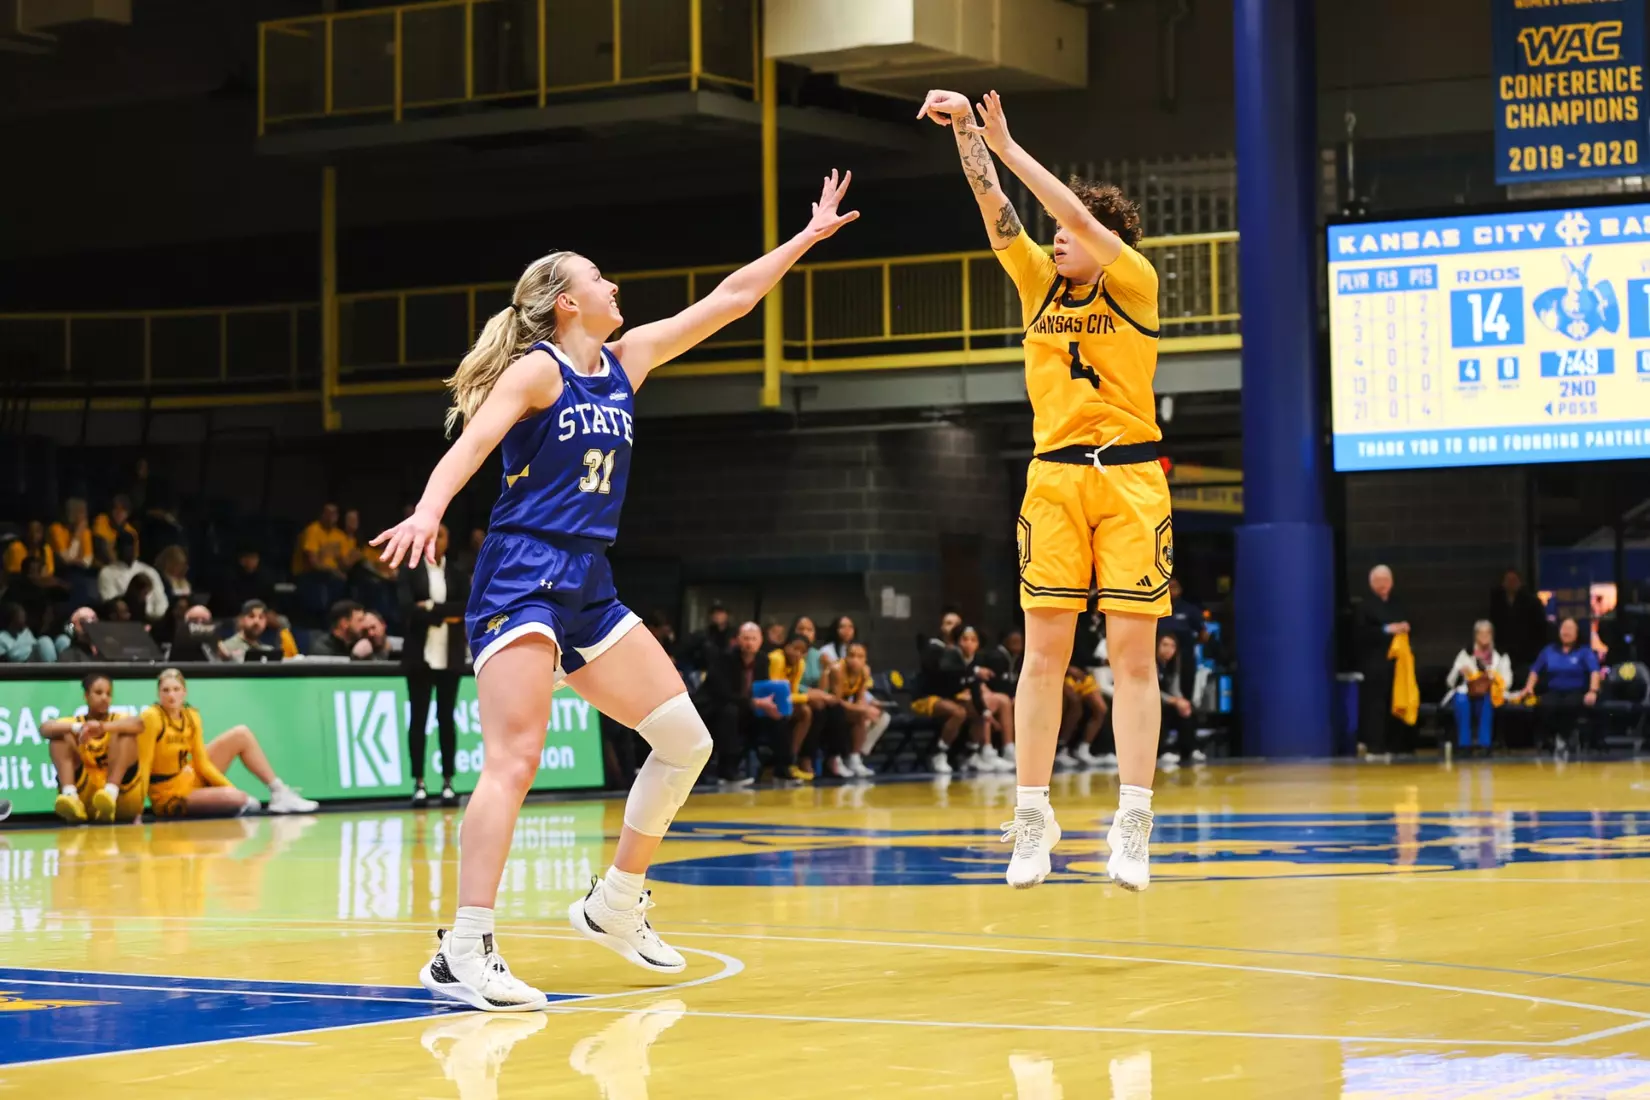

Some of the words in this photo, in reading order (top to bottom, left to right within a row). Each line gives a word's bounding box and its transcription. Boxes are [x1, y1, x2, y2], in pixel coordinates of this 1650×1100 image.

[1517, 20, 1623, 66] WAC
[1500, 66, 1643, 100] CONFERENCE
[1505, 96, 1638, 129] CHAMPIONS
[1508, 140, 1638, 172] 2019-2020
[1338, 229, 1460, 254] KANSAS
[1473, 222, 1545, 245] CITY
[1338, 271, 1370, 290] PLYR
[1376, 270, 1398, 288] FLS
[1409, 268, 1433, 286] PTS
[1457, 267, 1521, 283] ROOS
[1387, 296, 1395, 315] 0
[1467, 292, 1510, 342] 14
[1387, 321, 1396, 340] 0
[1068, 341, 1101, 389] 4
[1388, 348, 1397, 366] 0
[1464, 359, 1476, 380] 4
[1503, 358, 1515, 378] 0
[1555, 348, 1599, 376] 7:49
[1388, 374, 1397, 393] 0
[1421, 373, 1430, 392] 0
[1559, 380, 1596, 398] 2ND
[1389, 399, 1398, 418] 0
[1558, 401, 1598, 416] POSS
[558, 403, 633, 448] STATE
[1358, 440, 1405, 457] THANK
[1410, 438, 1439, 455] YOU
[1444, 437, 1463, 454] TO
[1468, 435, 1498, 453] OUR
[1503, 431, 1580, 452] FOUNDING
[579, 449, 616, 494] 31
[547, 697, 590, 732] ITY
